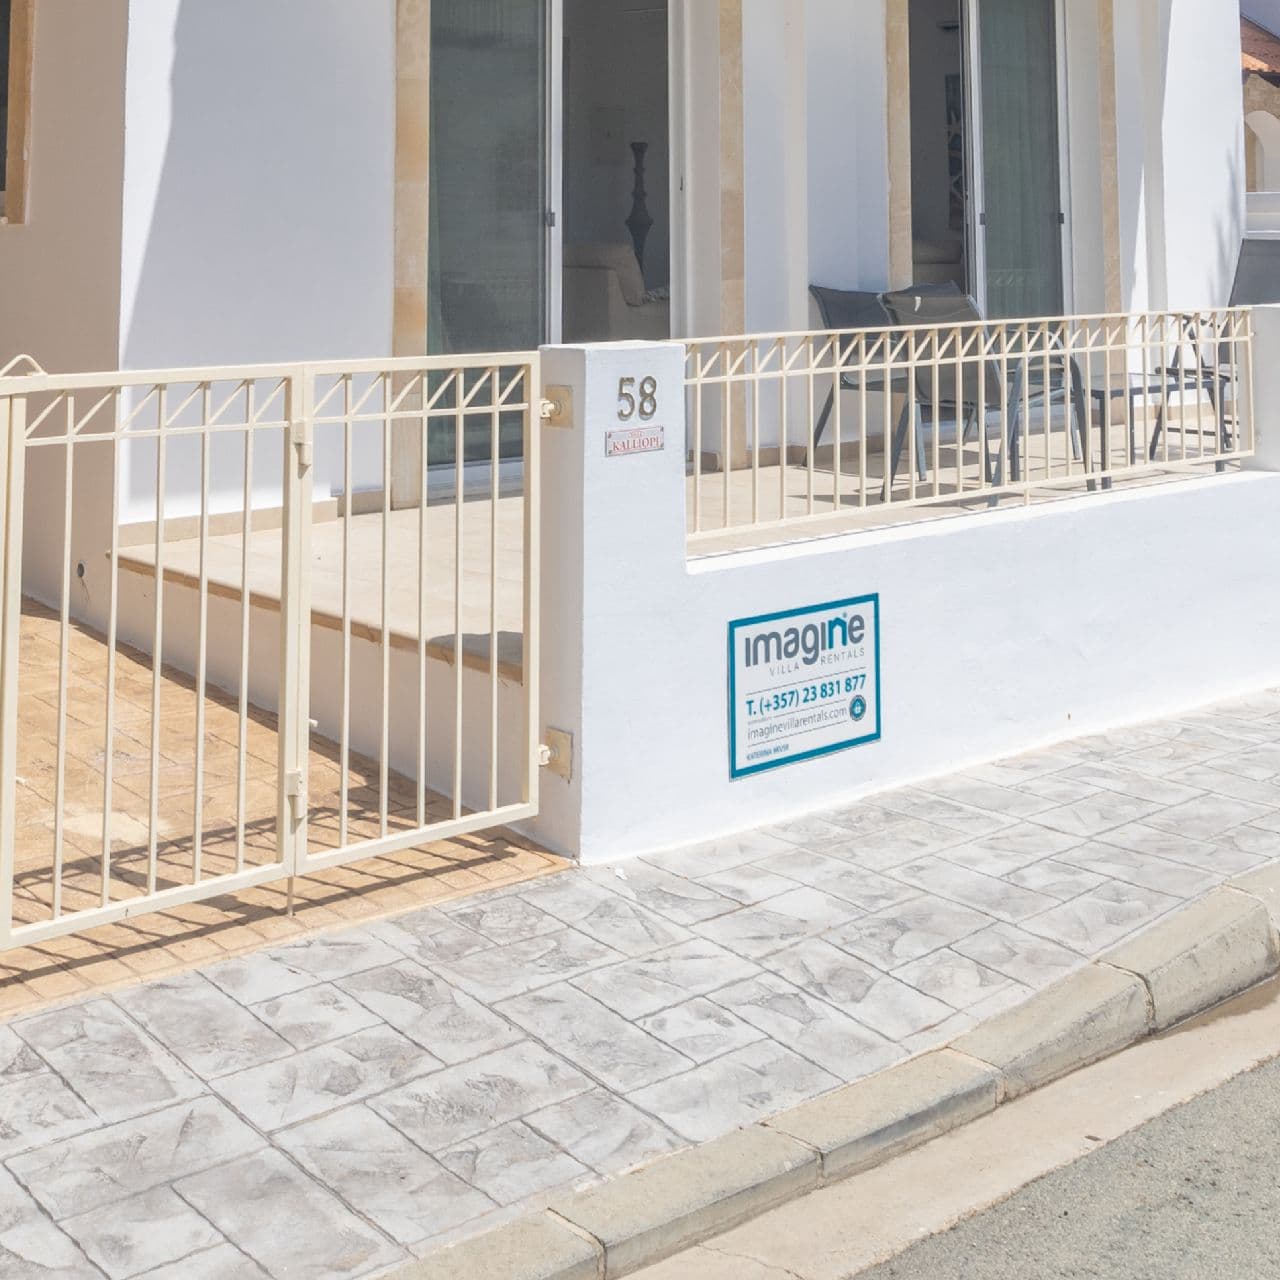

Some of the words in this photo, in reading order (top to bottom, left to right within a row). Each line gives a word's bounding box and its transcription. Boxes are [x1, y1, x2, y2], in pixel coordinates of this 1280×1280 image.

[617, 375, 657, 420] 58
[612, 437, 660, 451] KALLIOPI
[745, 612, 865, 668] imagine
[769, 662, 800, 676] VILLA
[820, 647, 865, 665] RENTALS
[746, 700, 757, 716] T.
[760, 689, 799, 715] (+357)
[802, 685, 818, 703] 23
[820, 680, 841, 698] 831
[845, 674, 866, 693] 877
[747, 706, 847, 740] imaginevillarentals.com
